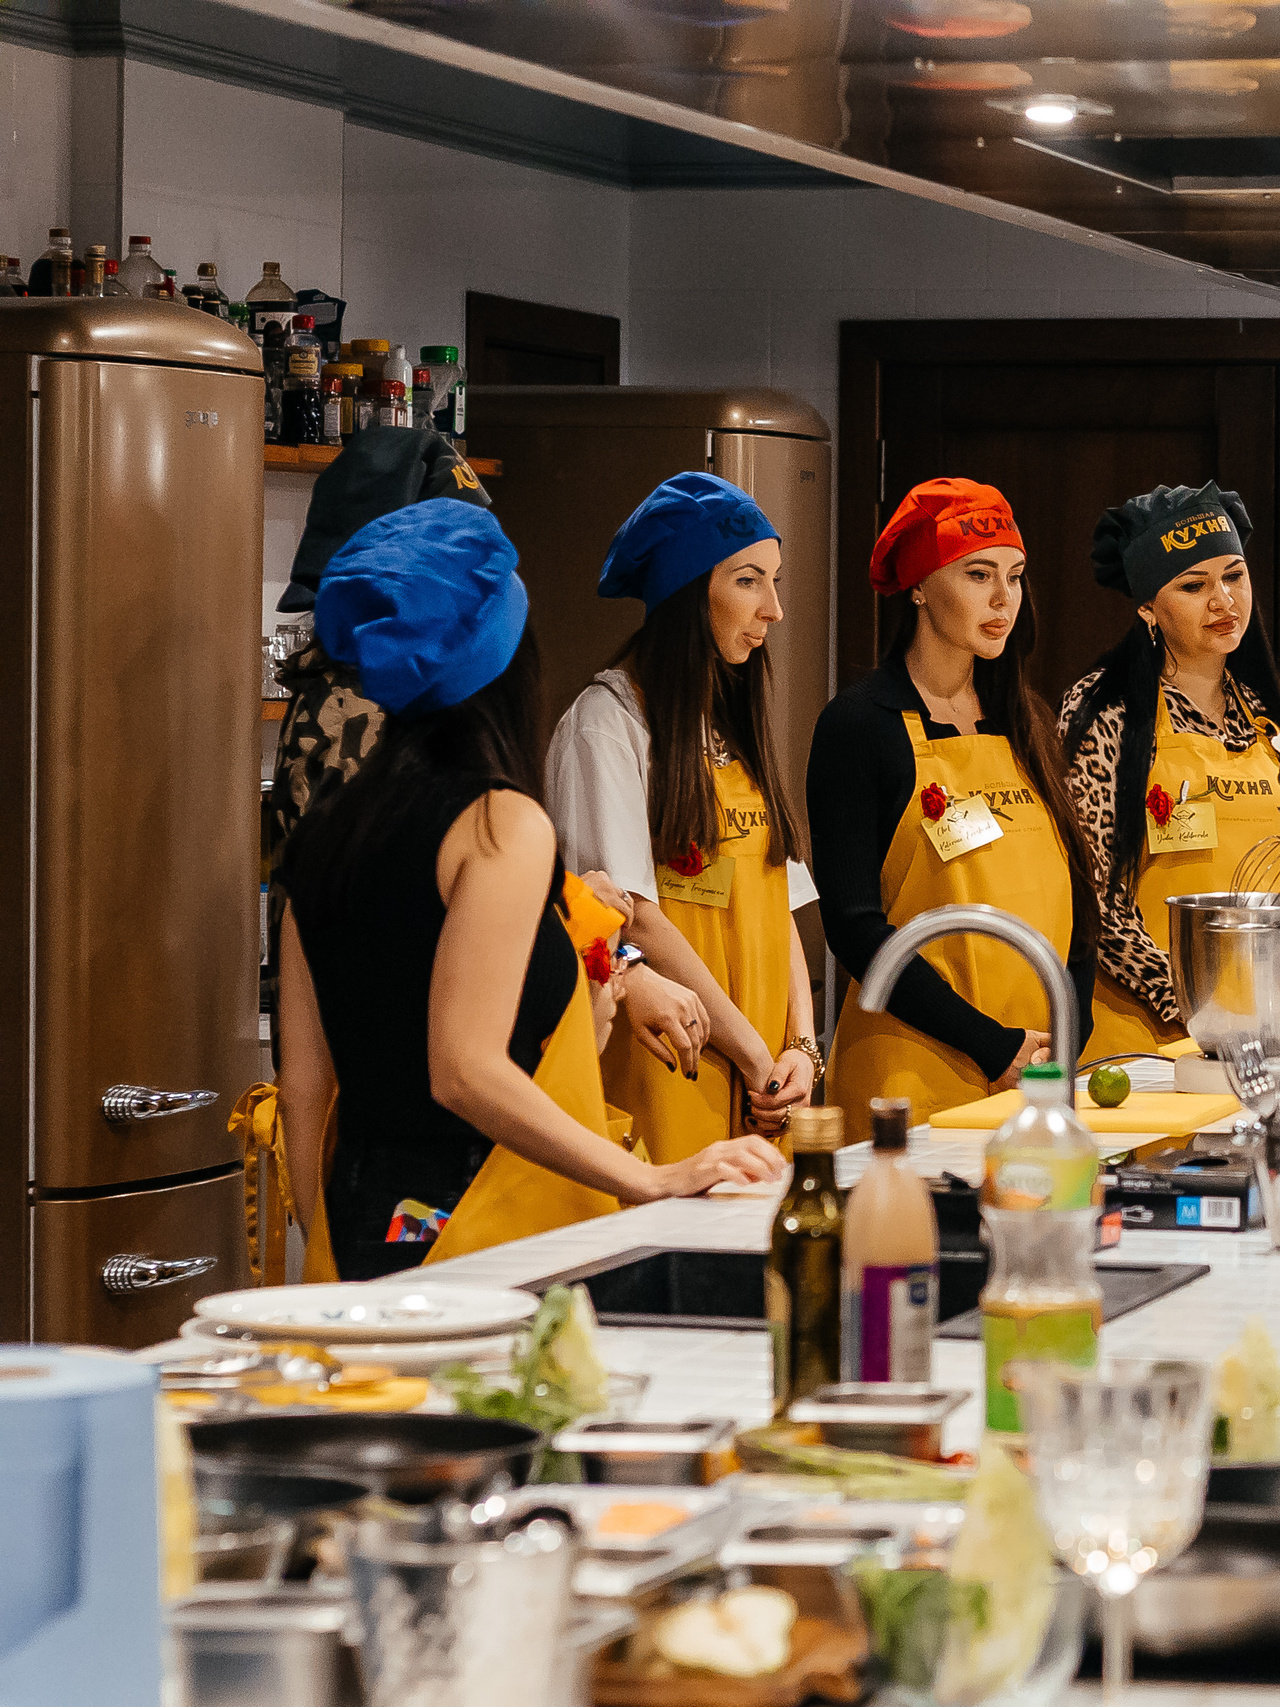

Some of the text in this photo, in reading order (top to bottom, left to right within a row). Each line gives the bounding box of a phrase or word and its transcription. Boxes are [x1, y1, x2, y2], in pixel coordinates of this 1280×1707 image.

[1160, 515, 1232, 553] КУХНЯ
[1206, 775, 1273, 801] КУХНЯ
[725, 808, 769, 835] КУХН
